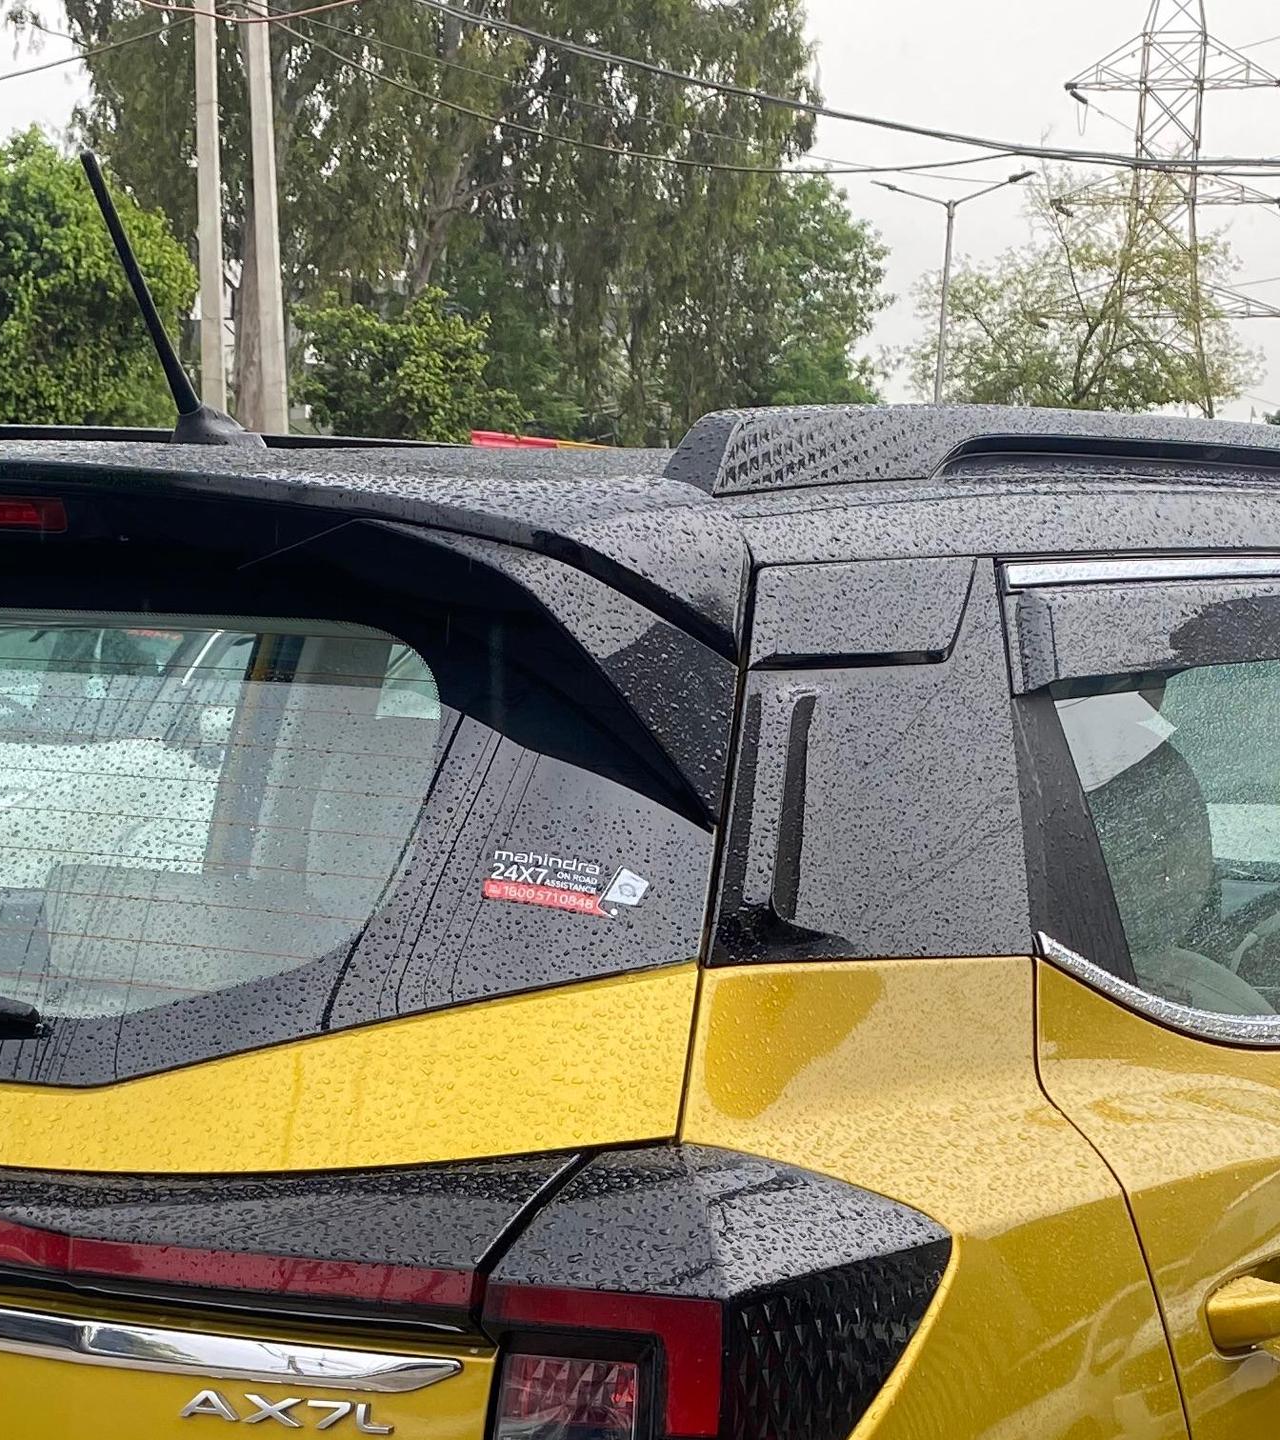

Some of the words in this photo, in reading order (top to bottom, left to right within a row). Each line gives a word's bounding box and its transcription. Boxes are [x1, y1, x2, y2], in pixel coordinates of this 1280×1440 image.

[491, 862, 549, 885] 24X7
[494, 850, 600, 875] mahindra
[544, 878, 597, 895] ASSISTANCE
[556, 871, 571, 881] ON
[572, 874, 598, 885] ROAD
[179, 1389, 395, 1435] AX7L
